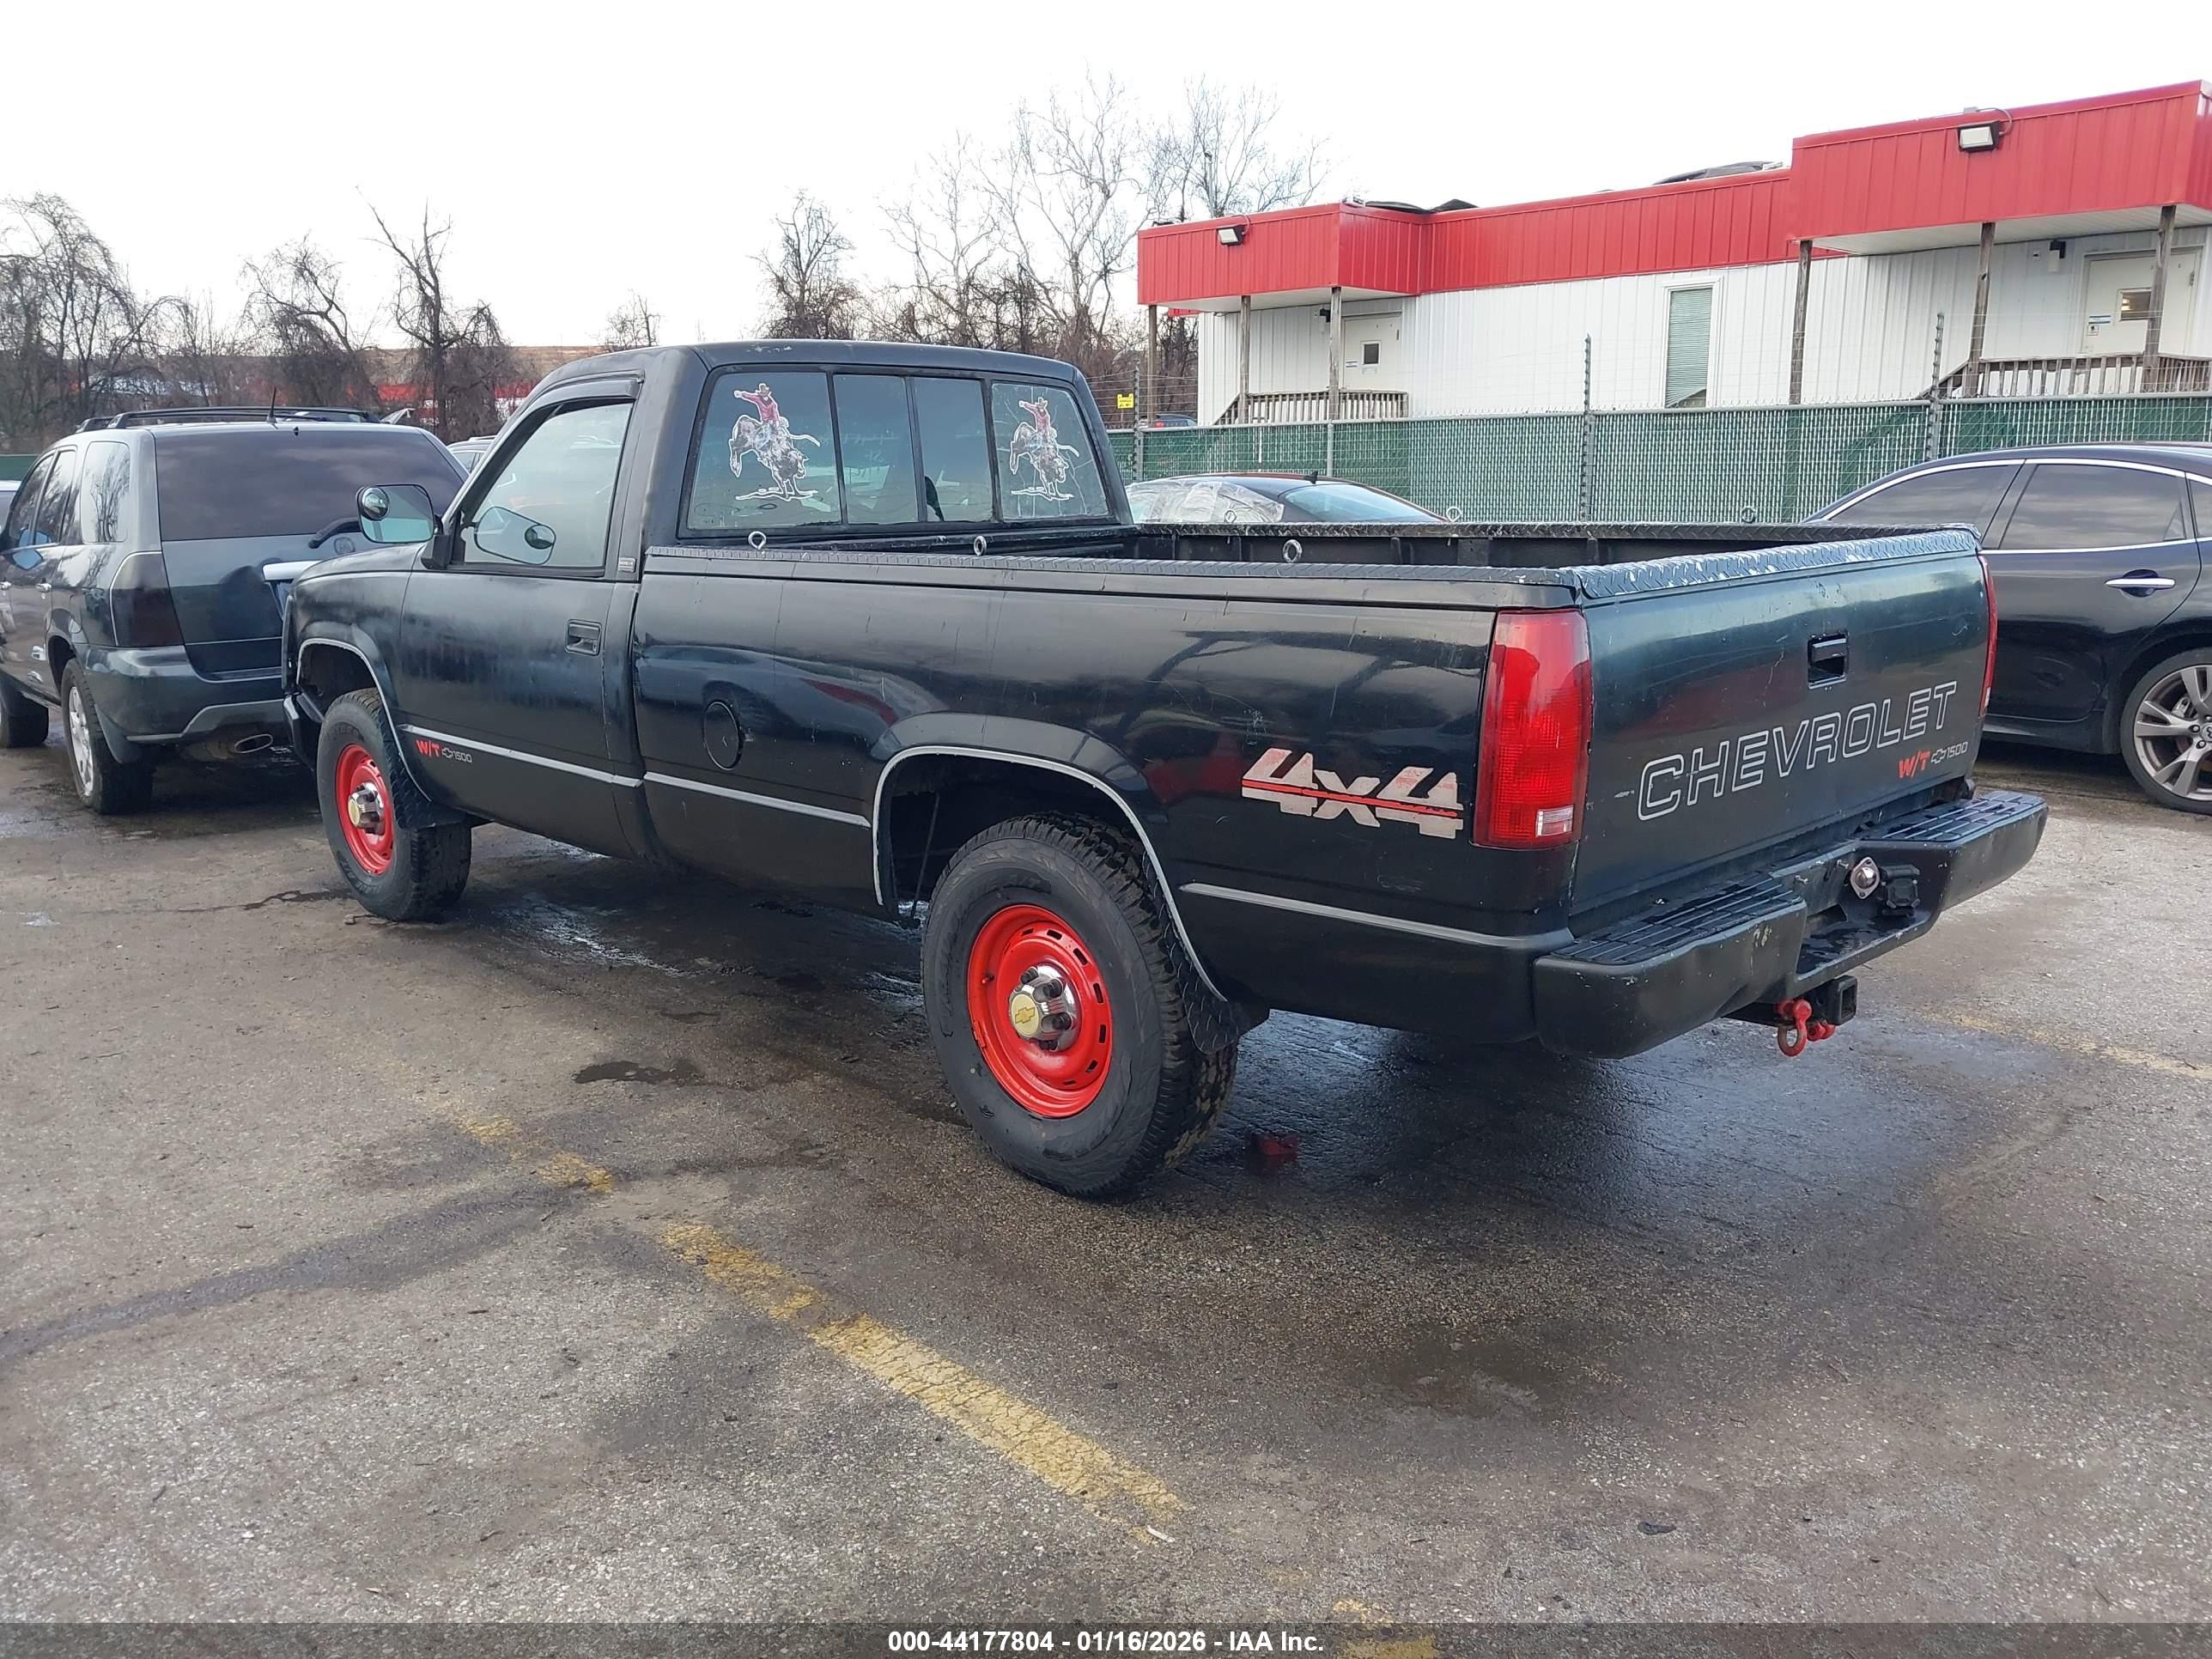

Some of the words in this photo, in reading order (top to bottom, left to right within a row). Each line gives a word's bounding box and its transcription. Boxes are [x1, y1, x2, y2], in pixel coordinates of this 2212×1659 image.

[416, 739, 440, 757] W/T
[453, 750, 472, 763] 1500
[1638, 680, 1957, 821] CHEVROLET
[1898, 750, 1930, 779] W/T
[1945, 741, 1968, 759] 1500
